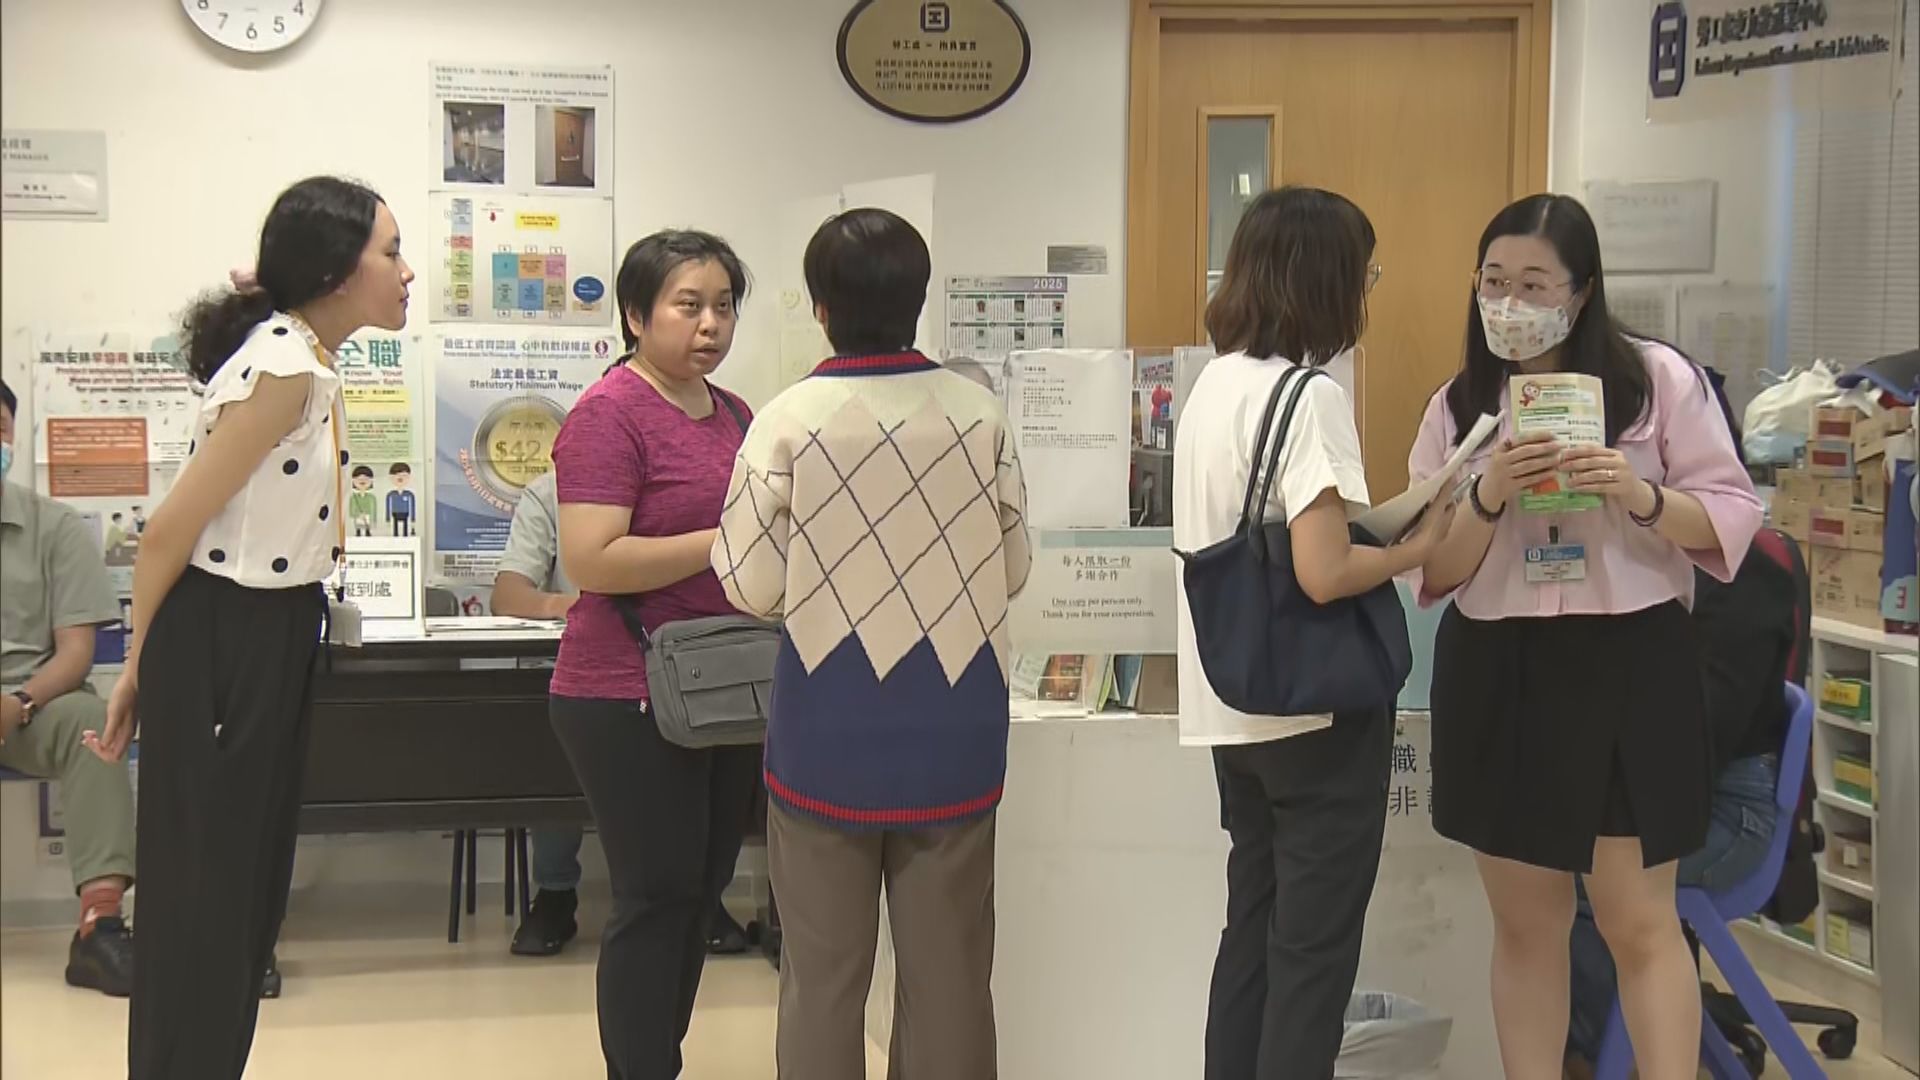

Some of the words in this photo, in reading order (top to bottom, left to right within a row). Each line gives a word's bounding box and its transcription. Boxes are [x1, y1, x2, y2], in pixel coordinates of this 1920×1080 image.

[218, 13, 228, 30] 7
[273, 16, 285, 33] 5
[246, 22, 257, 39] 6
[1034, 278, 1063, 289] 2025
[470, 380, 513, 391] Statutory
[515, 381, 556, 391] Minimum
[558, 382, 584, 392] Wage
[1051, 598, 1067, 606] One
[1069, 598, 1086, 607] copy
[1087, 598, 1100, 606] per
[1101, 598, 1126, 606] person
[1041, 610, 1063, 619] Thank
[1065, 610, 1079, 619] you
[1081, 610, 1092, 618] for
[1093, 610, 1110, 619] your
